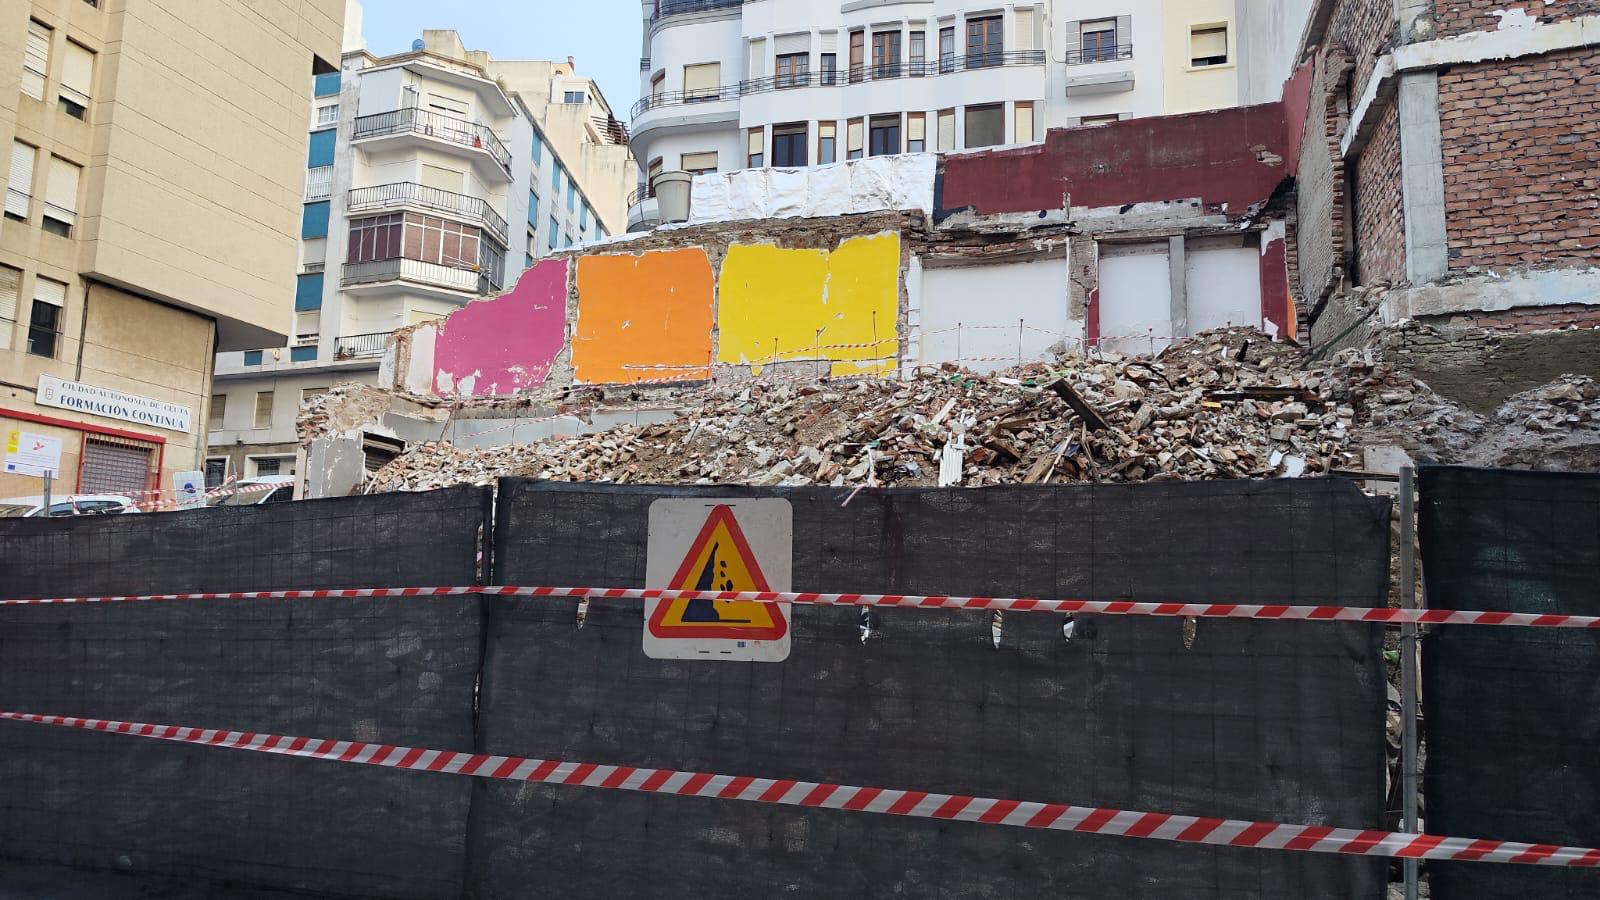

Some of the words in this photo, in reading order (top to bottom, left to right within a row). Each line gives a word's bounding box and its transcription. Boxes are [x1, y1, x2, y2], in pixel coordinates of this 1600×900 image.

[62, 382, 96, 395] CIUDAD
[150, 401, 160, 409] DE
[60, 394, 129, 417] FORMACIÓN
[132, 409, 184, 429] CONTINUA
